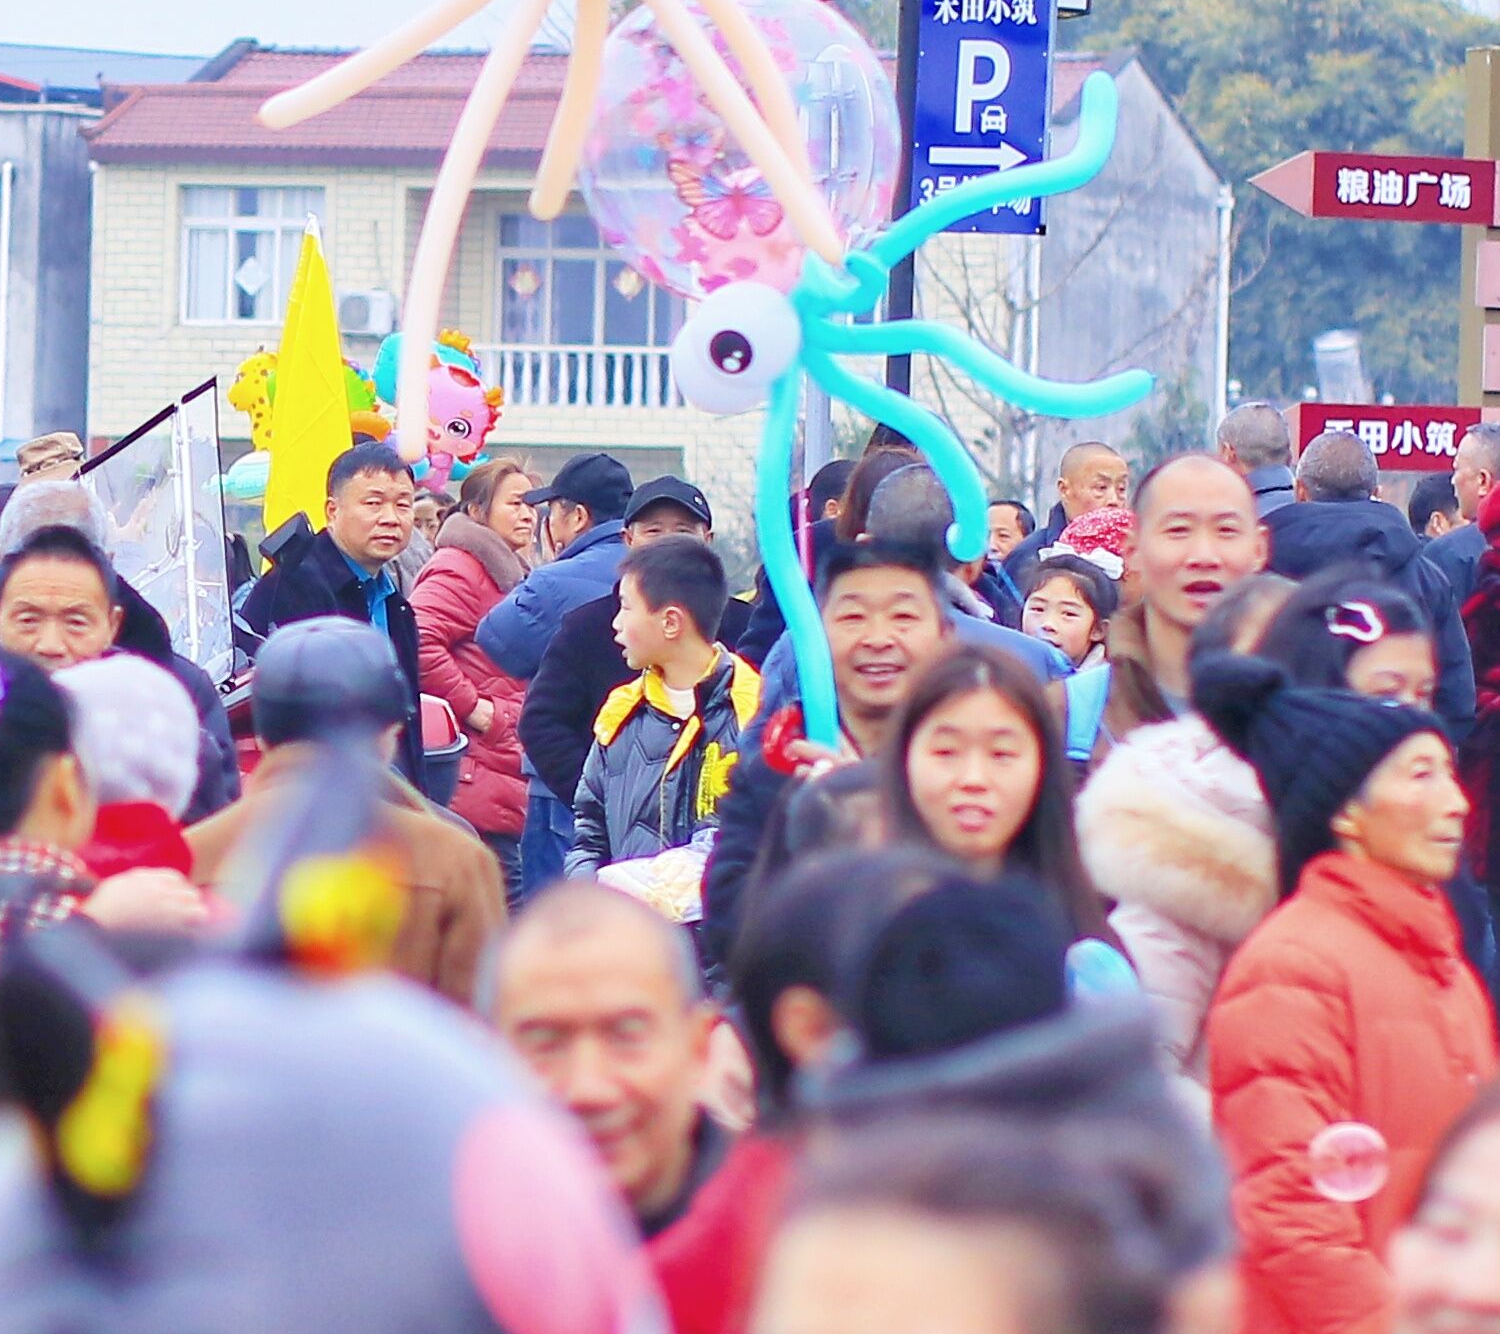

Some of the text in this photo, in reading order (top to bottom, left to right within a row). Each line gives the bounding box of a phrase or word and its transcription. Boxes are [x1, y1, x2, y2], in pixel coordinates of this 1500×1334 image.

[954, 39, 1011, 133] P
[1337, 168, 1471, 208] 粮油广场
